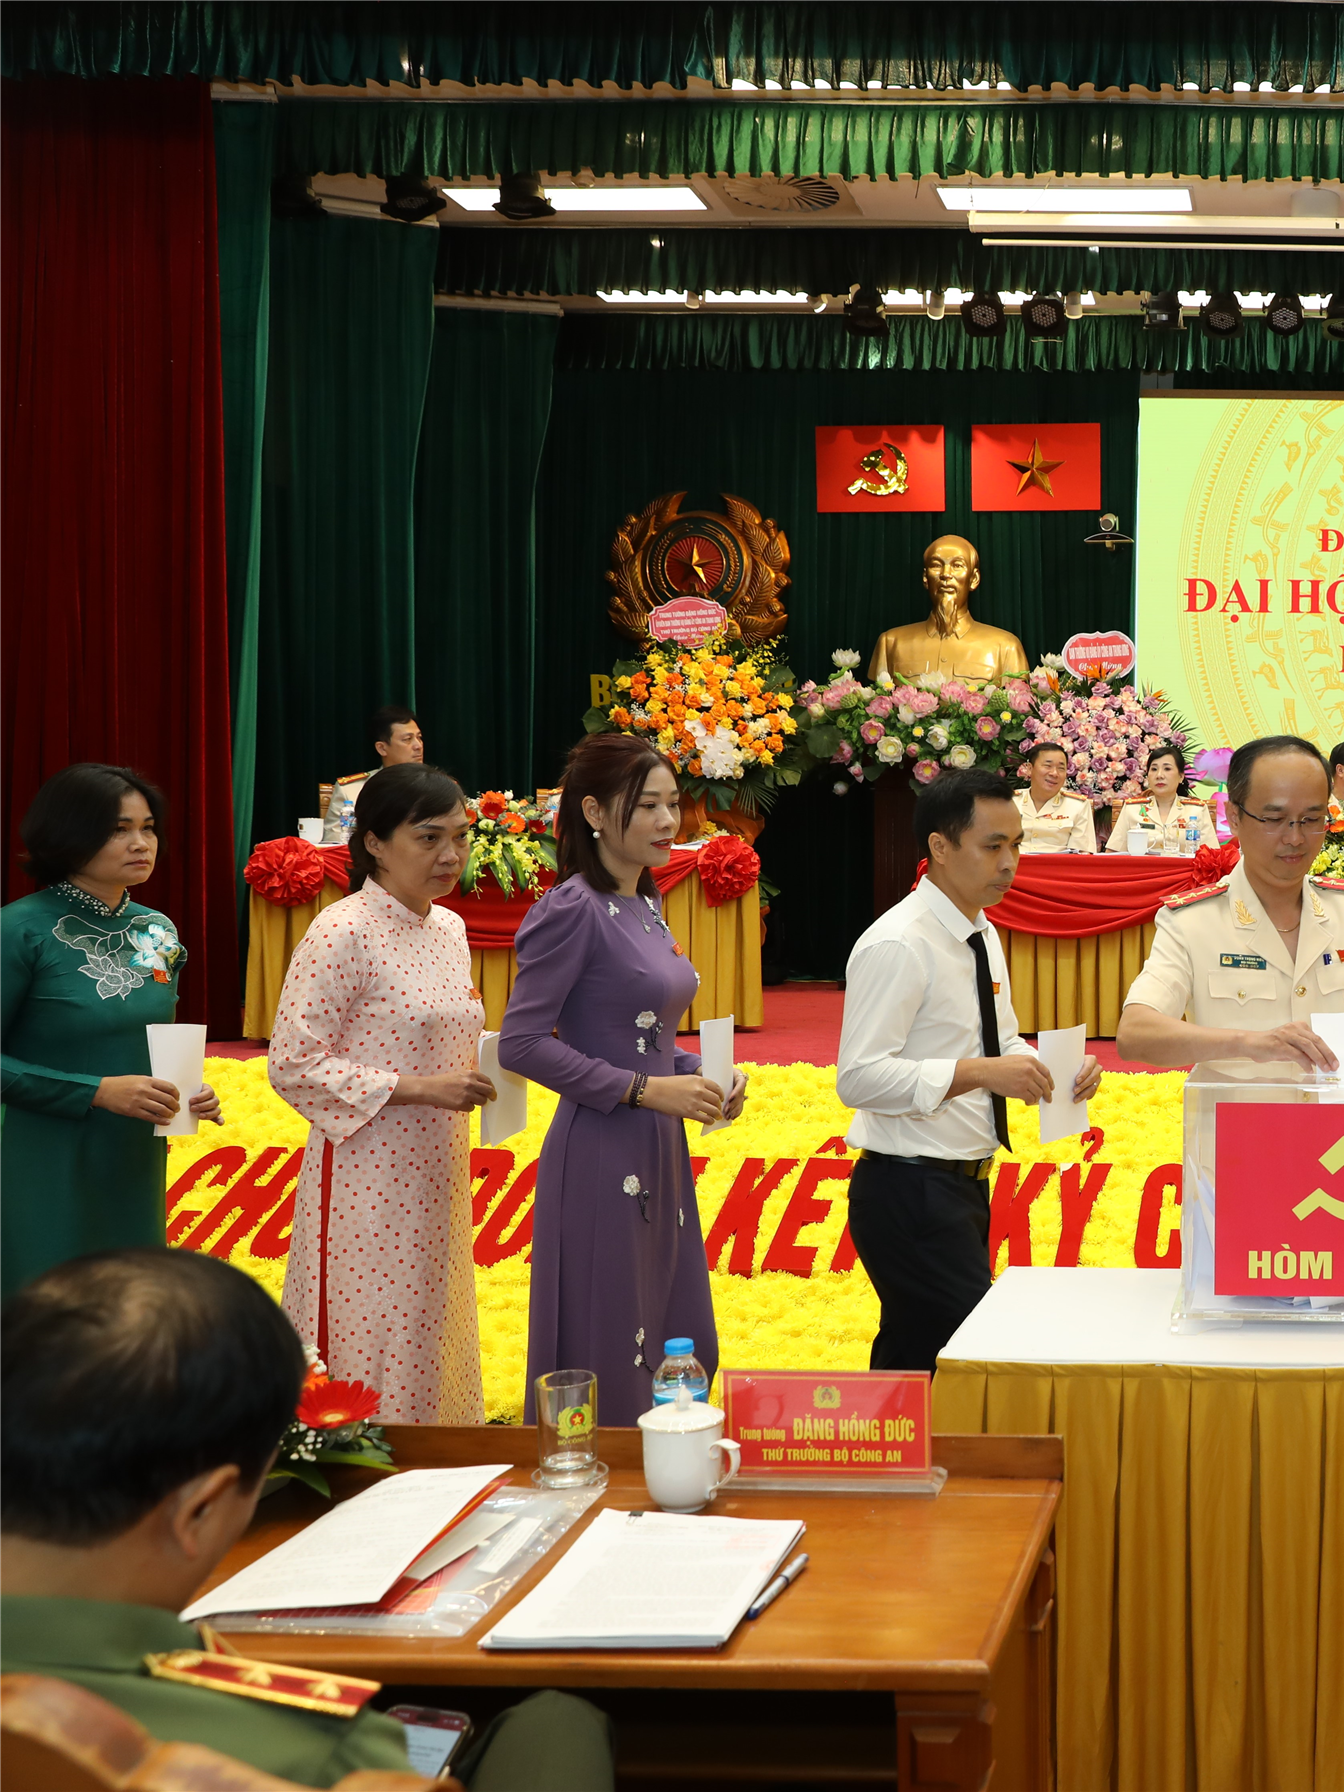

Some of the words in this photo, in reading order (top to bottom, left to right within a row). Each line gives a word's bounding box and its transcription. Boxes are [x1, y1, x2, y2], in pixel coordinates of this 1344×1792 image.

[1183, 577, 1273, 623] ĐẠI
[990, 1127, 1112, 1283] KỶ
[1248, 1243, 1333, 1280] HÒM
[739, 1426, 762, 1442] Trung
[793, 1413, 835, 1445] ĐẶNG
[839, 1411, 880, 1442] HỒNG
[884, 1415, 915, 1442] ĐỨC
[762, 1447, 785, 1461] THỨ
[786, 1444, 831, 1462] TRƯỞNG
[834, 1447, 849, 1465] BỘ
[852, 1447, 882, 1462] CÔNG
[885, 1450, 902, 1463] AN
